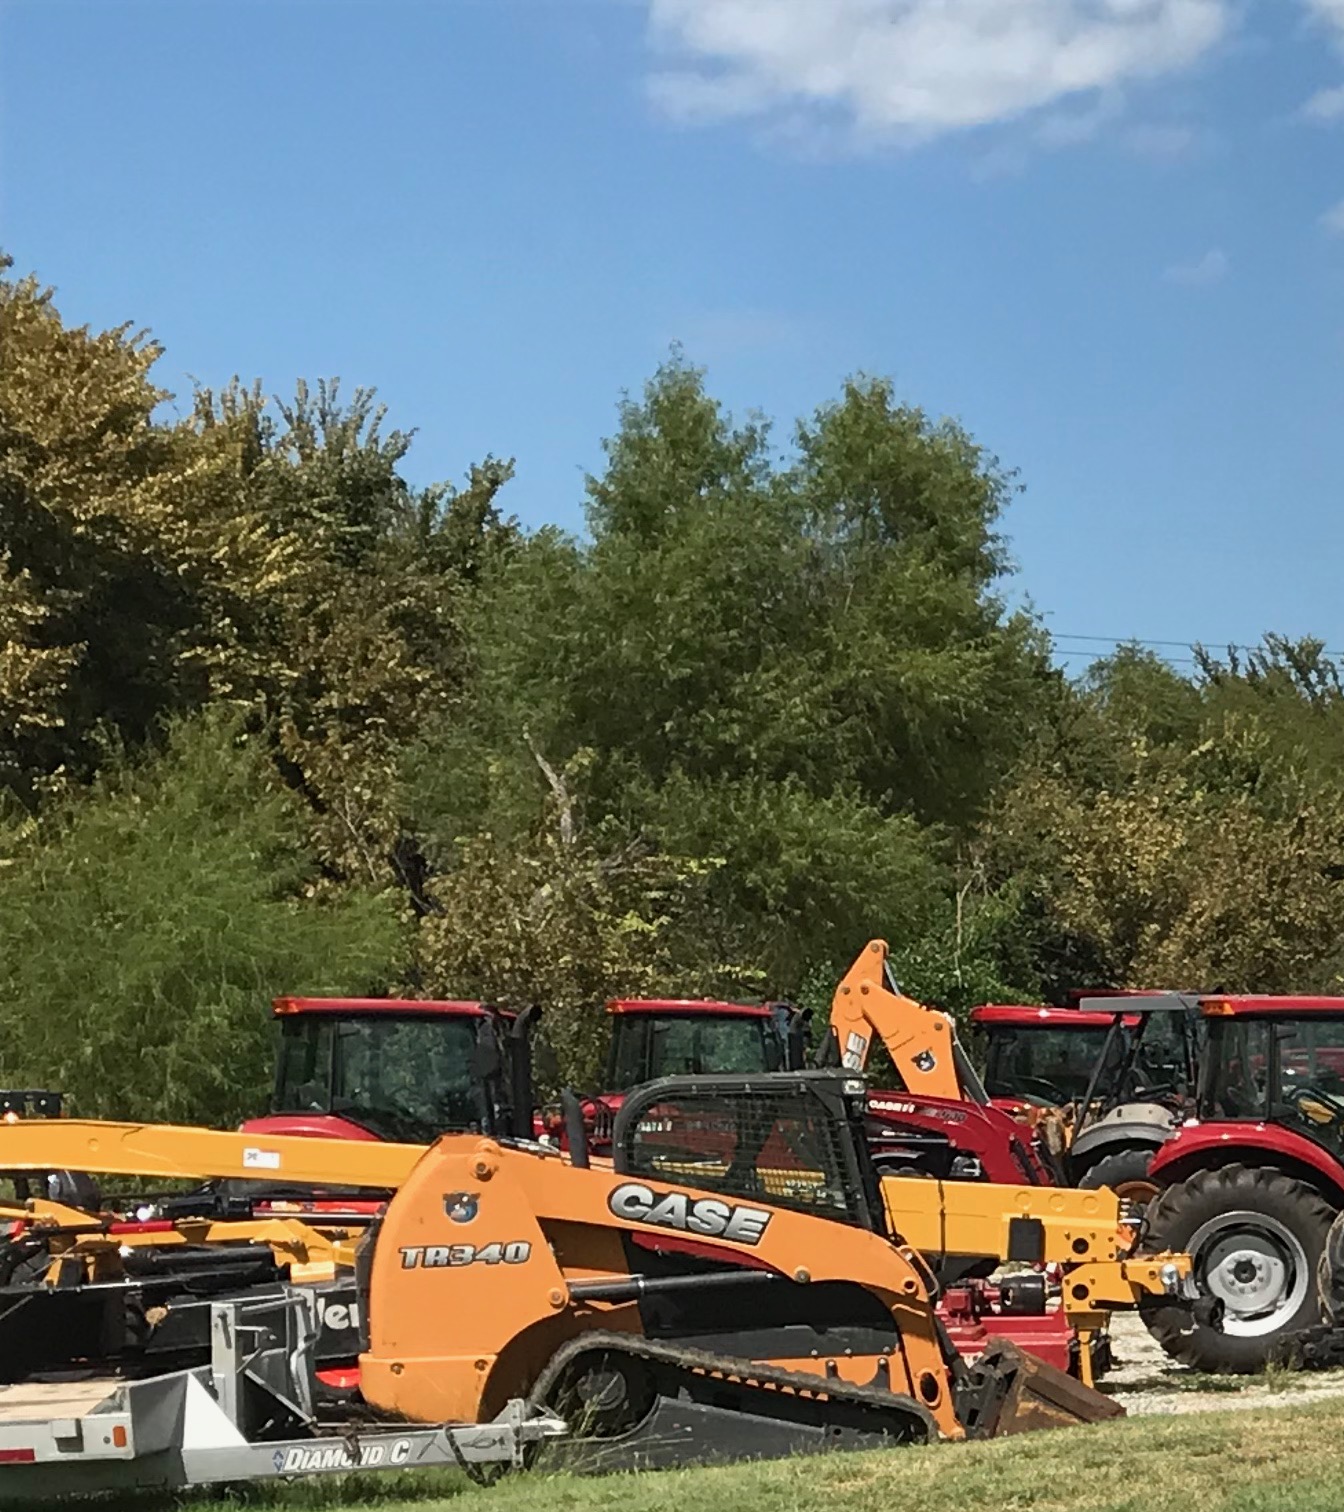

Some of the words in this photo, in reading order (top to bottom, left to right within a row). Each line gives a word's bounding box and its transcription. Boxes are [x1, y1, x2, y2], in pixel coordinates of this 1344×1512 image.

[609, 1183, 772, 1244] CASE
[400, 1241, 532, 1268] TR340
[390, 1440, 410, 1463] C
